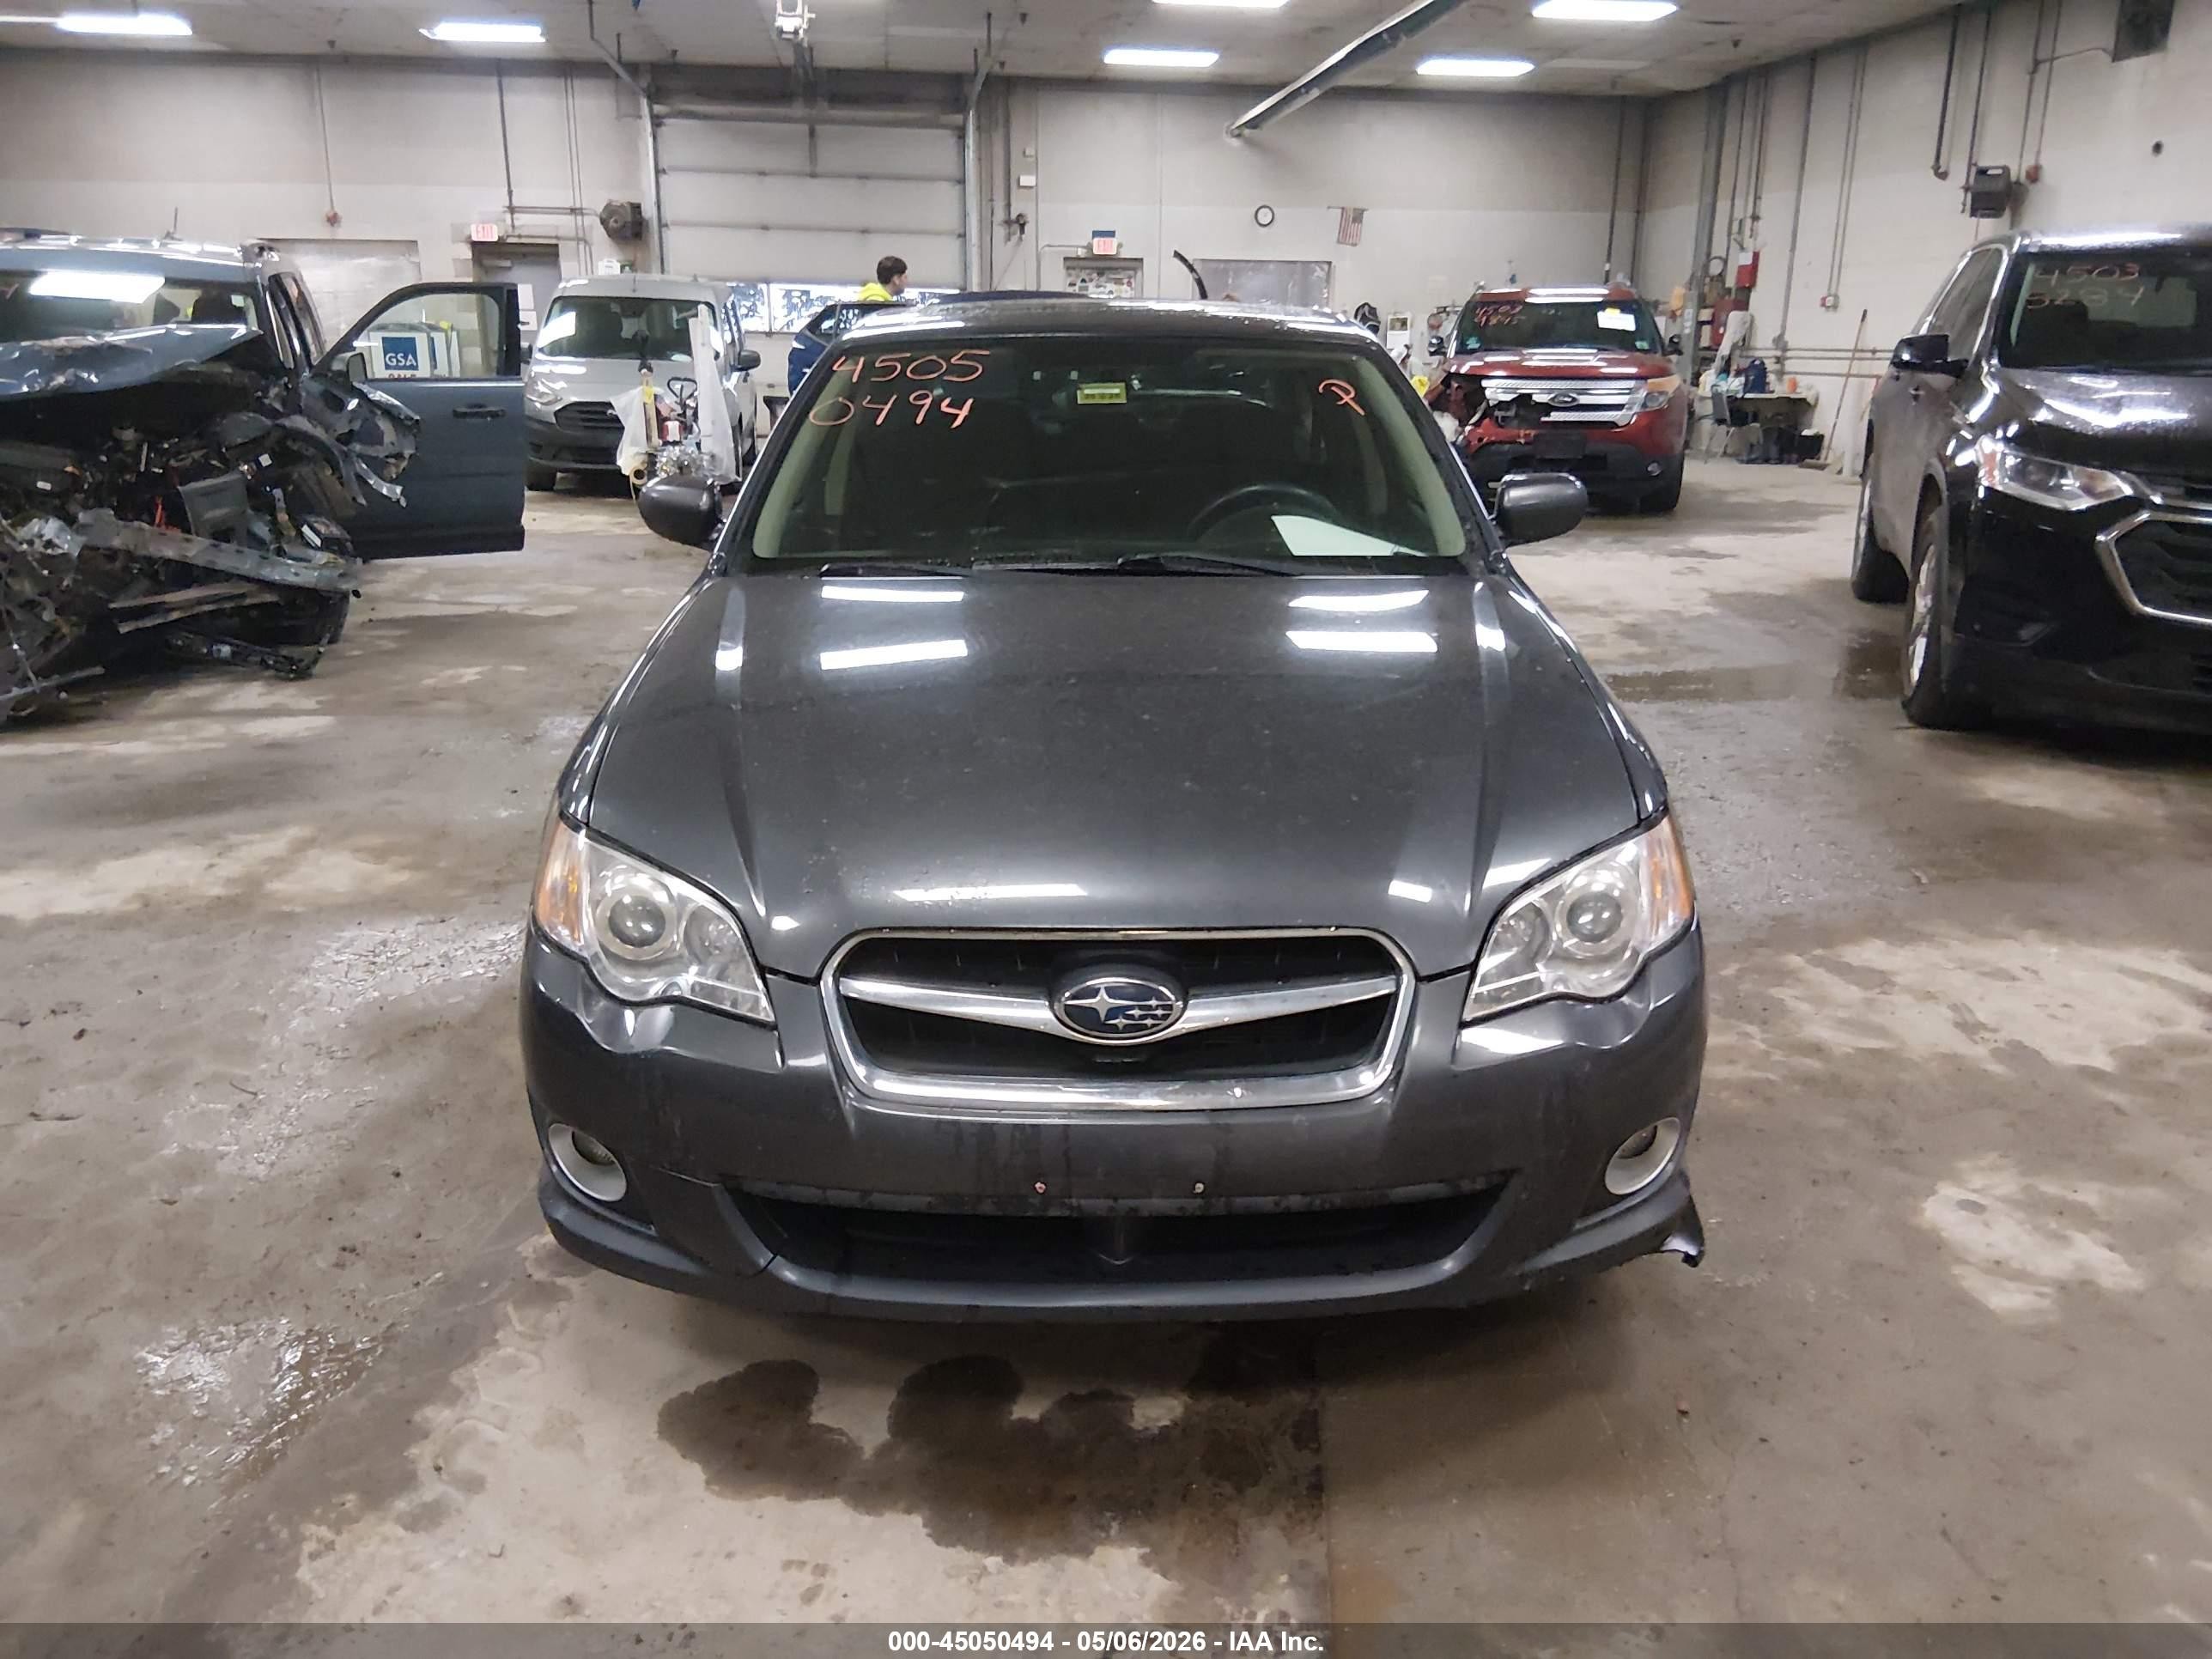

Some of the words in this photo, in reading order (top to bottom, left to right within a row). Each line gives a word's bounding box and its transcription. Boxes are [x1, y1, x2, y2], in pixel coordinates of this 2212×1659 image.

[386, 353, 416, 366] GSA
[832, 349, 990, 383] 4505
[809, 390, 975, 428] 0494
